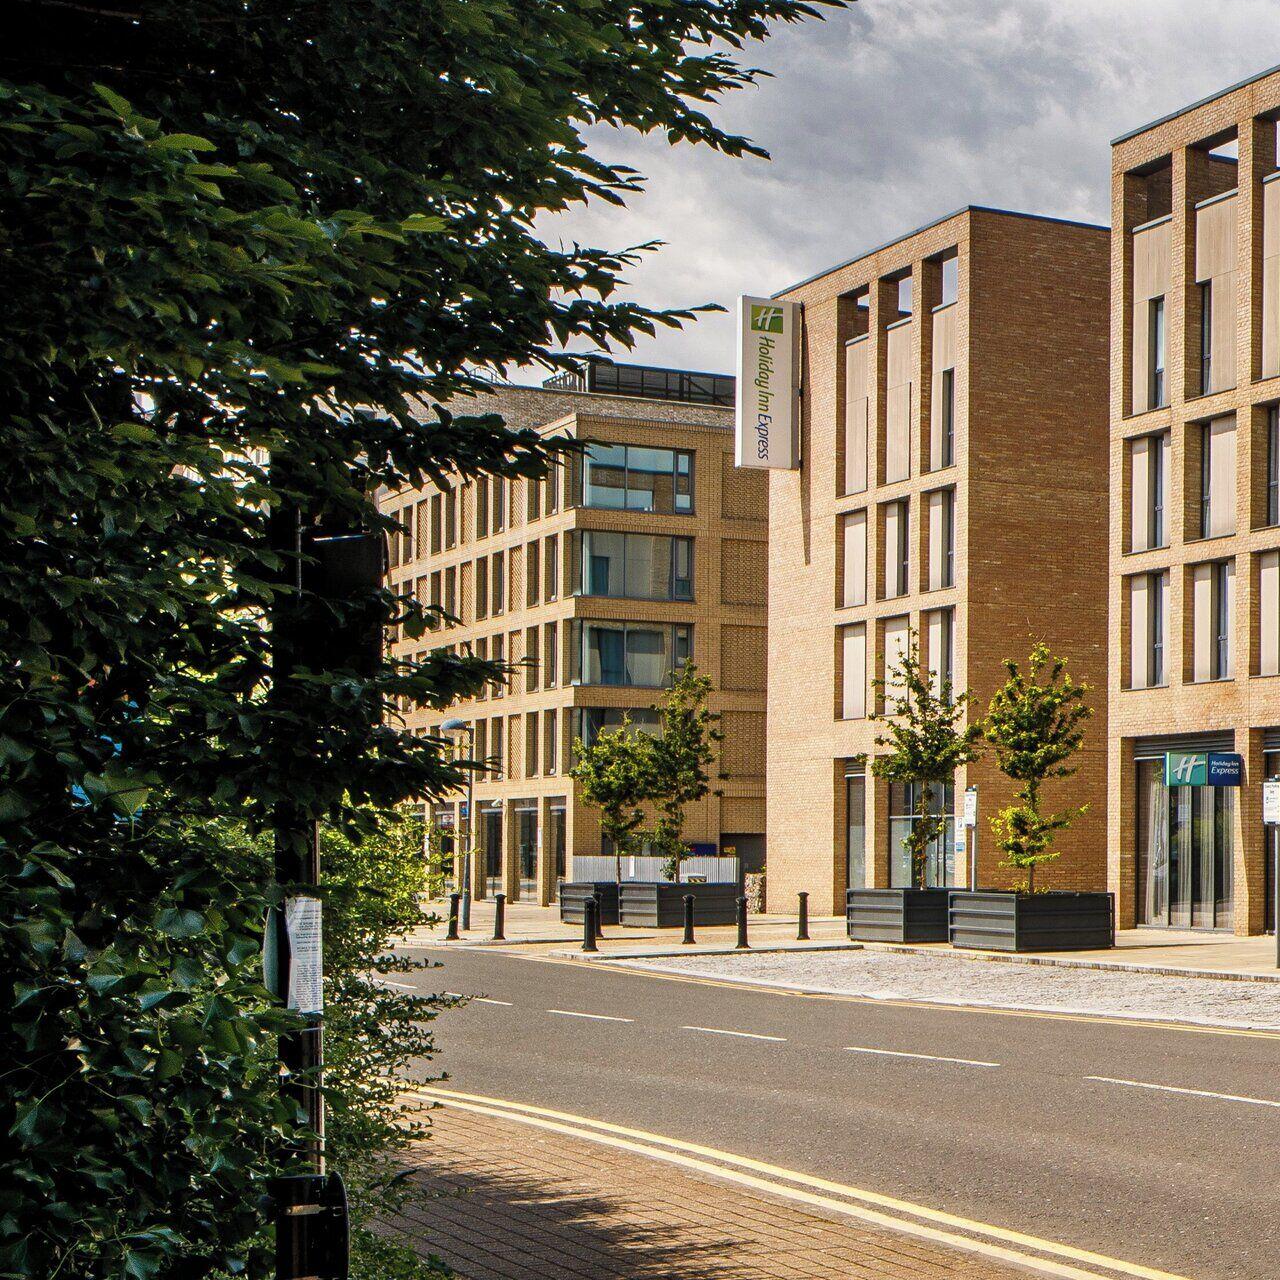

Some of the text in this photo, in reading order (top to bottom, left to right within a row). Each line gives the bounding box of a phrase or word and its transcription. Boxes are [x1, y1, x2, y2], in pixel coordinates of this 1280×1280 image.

[754, 336, 776, 461] Holiday Inn Express
[1211, 766, 1239, 775] Express
